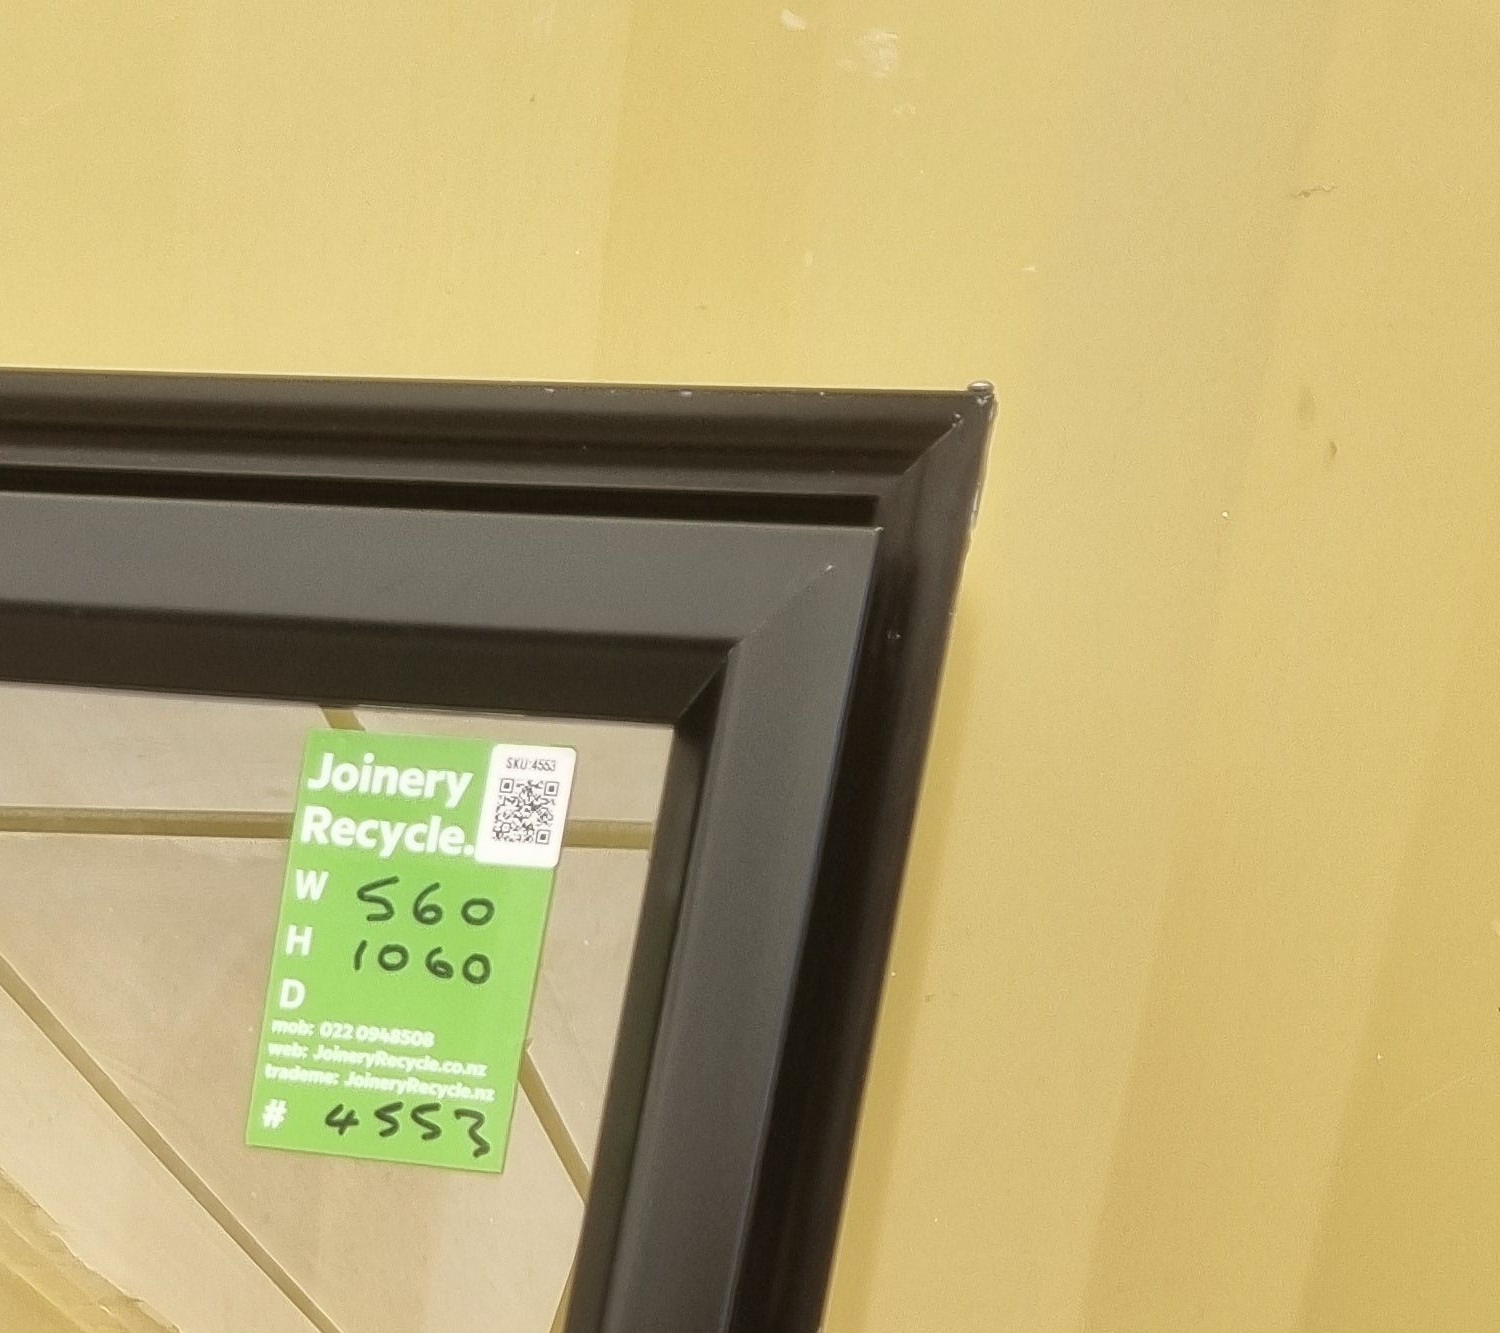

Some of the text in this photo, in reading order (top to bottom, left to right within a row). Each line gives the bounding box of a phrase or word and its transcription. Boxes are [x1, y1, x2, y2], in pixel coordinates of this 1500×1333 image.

[307, 752, 474, 808] Joinery
[300, 805, 475, 858] Recycle.
[295, 868, 329, 900] W
[357, 876, 495, 926] 560
[285, 925, 313, 956] H
[353, 939, 491, 985] 1060
[279, 979, 306, 1009] D
[271, 1018, 315, 1036] mob:
[319, 1021, 354, 1040] 022
[268, 1042, 488, 1077] web: JoineryRecycle.co.nz
[264, 1063, 496, 1102] trademe: JoineryRecycle.nz
[262, 1099, 288, 1129] #
[324, 1101, 491, 1158] 4553
